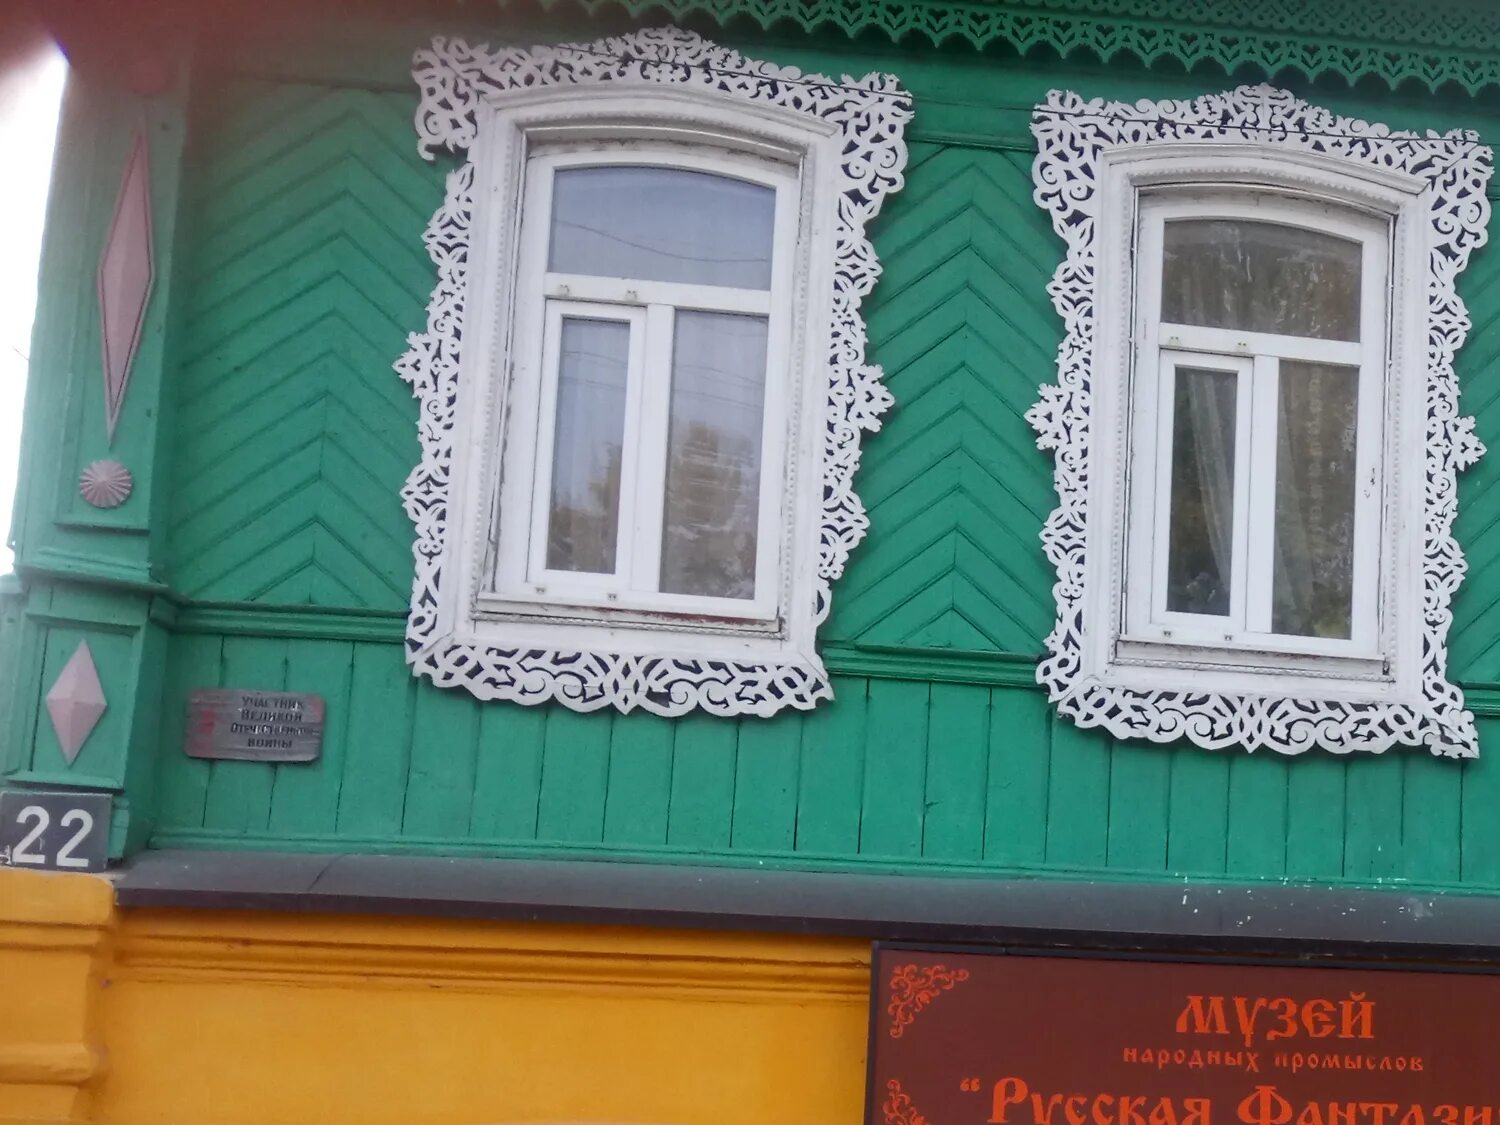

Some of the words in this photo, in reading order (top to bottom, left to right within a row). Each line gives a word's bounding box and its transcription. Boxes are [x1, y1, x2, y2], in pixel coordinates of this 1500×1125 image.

[12, 805, 94, 867] 22
[1175, 991, 1377, 1048] МУЗЕЙ
[1122, 1047, 1260, 1073] народных
[1274, 1052, 1424, 1074] промыслов
